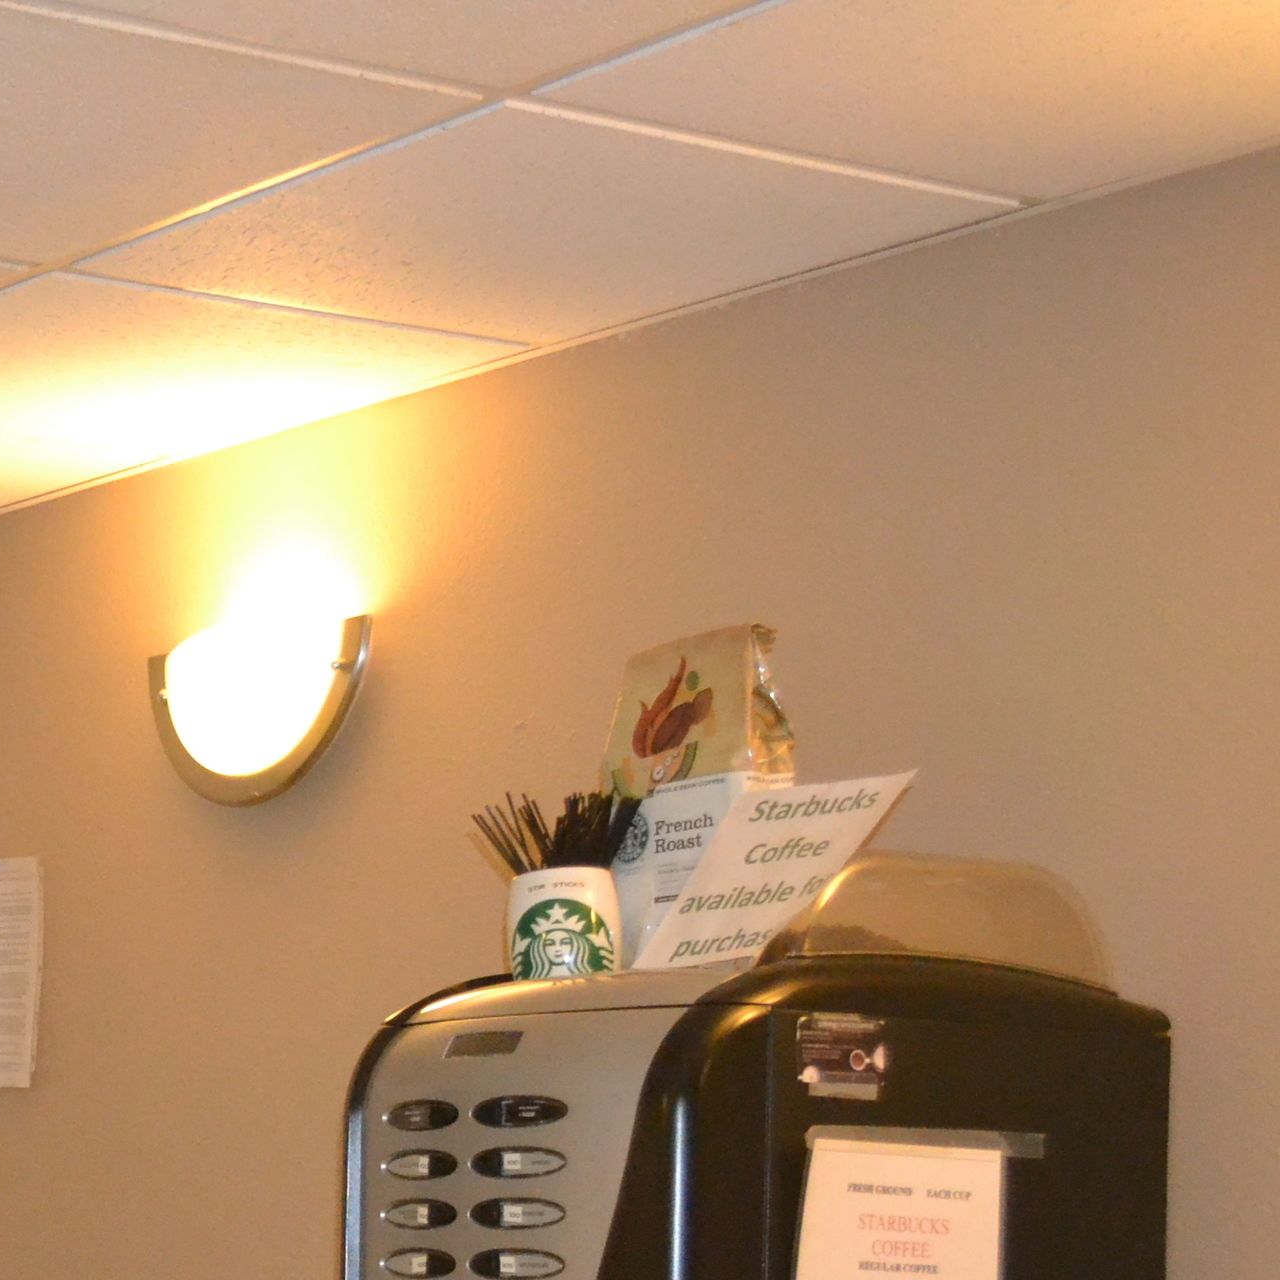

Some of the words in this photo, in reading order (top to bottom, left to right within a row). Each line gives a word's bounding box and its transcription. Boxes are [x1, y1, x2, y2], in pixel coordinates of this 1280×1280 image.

[748, 788, 880, 822] Starbucks
[654, 813, 714, 837] French
[654, 833, 704, 854] Roast
[744, 836, 830, 865] Coffee
[679, 881, 796, 915] available
[668, 928, 774, 963] purchas
[875, 1185, 913, 1197] GROUND
[926, 1189, 951, 1200] EACH
[952, 1190, 972, 1201] CUP
[858, 1213, 950, 1235] STARBUCKS
[871, 1239, 931, 1259] COFFEE
[858, 1261, 901, 1272] REGULAR
[902, 1263, 939, 1275] COFFEE
